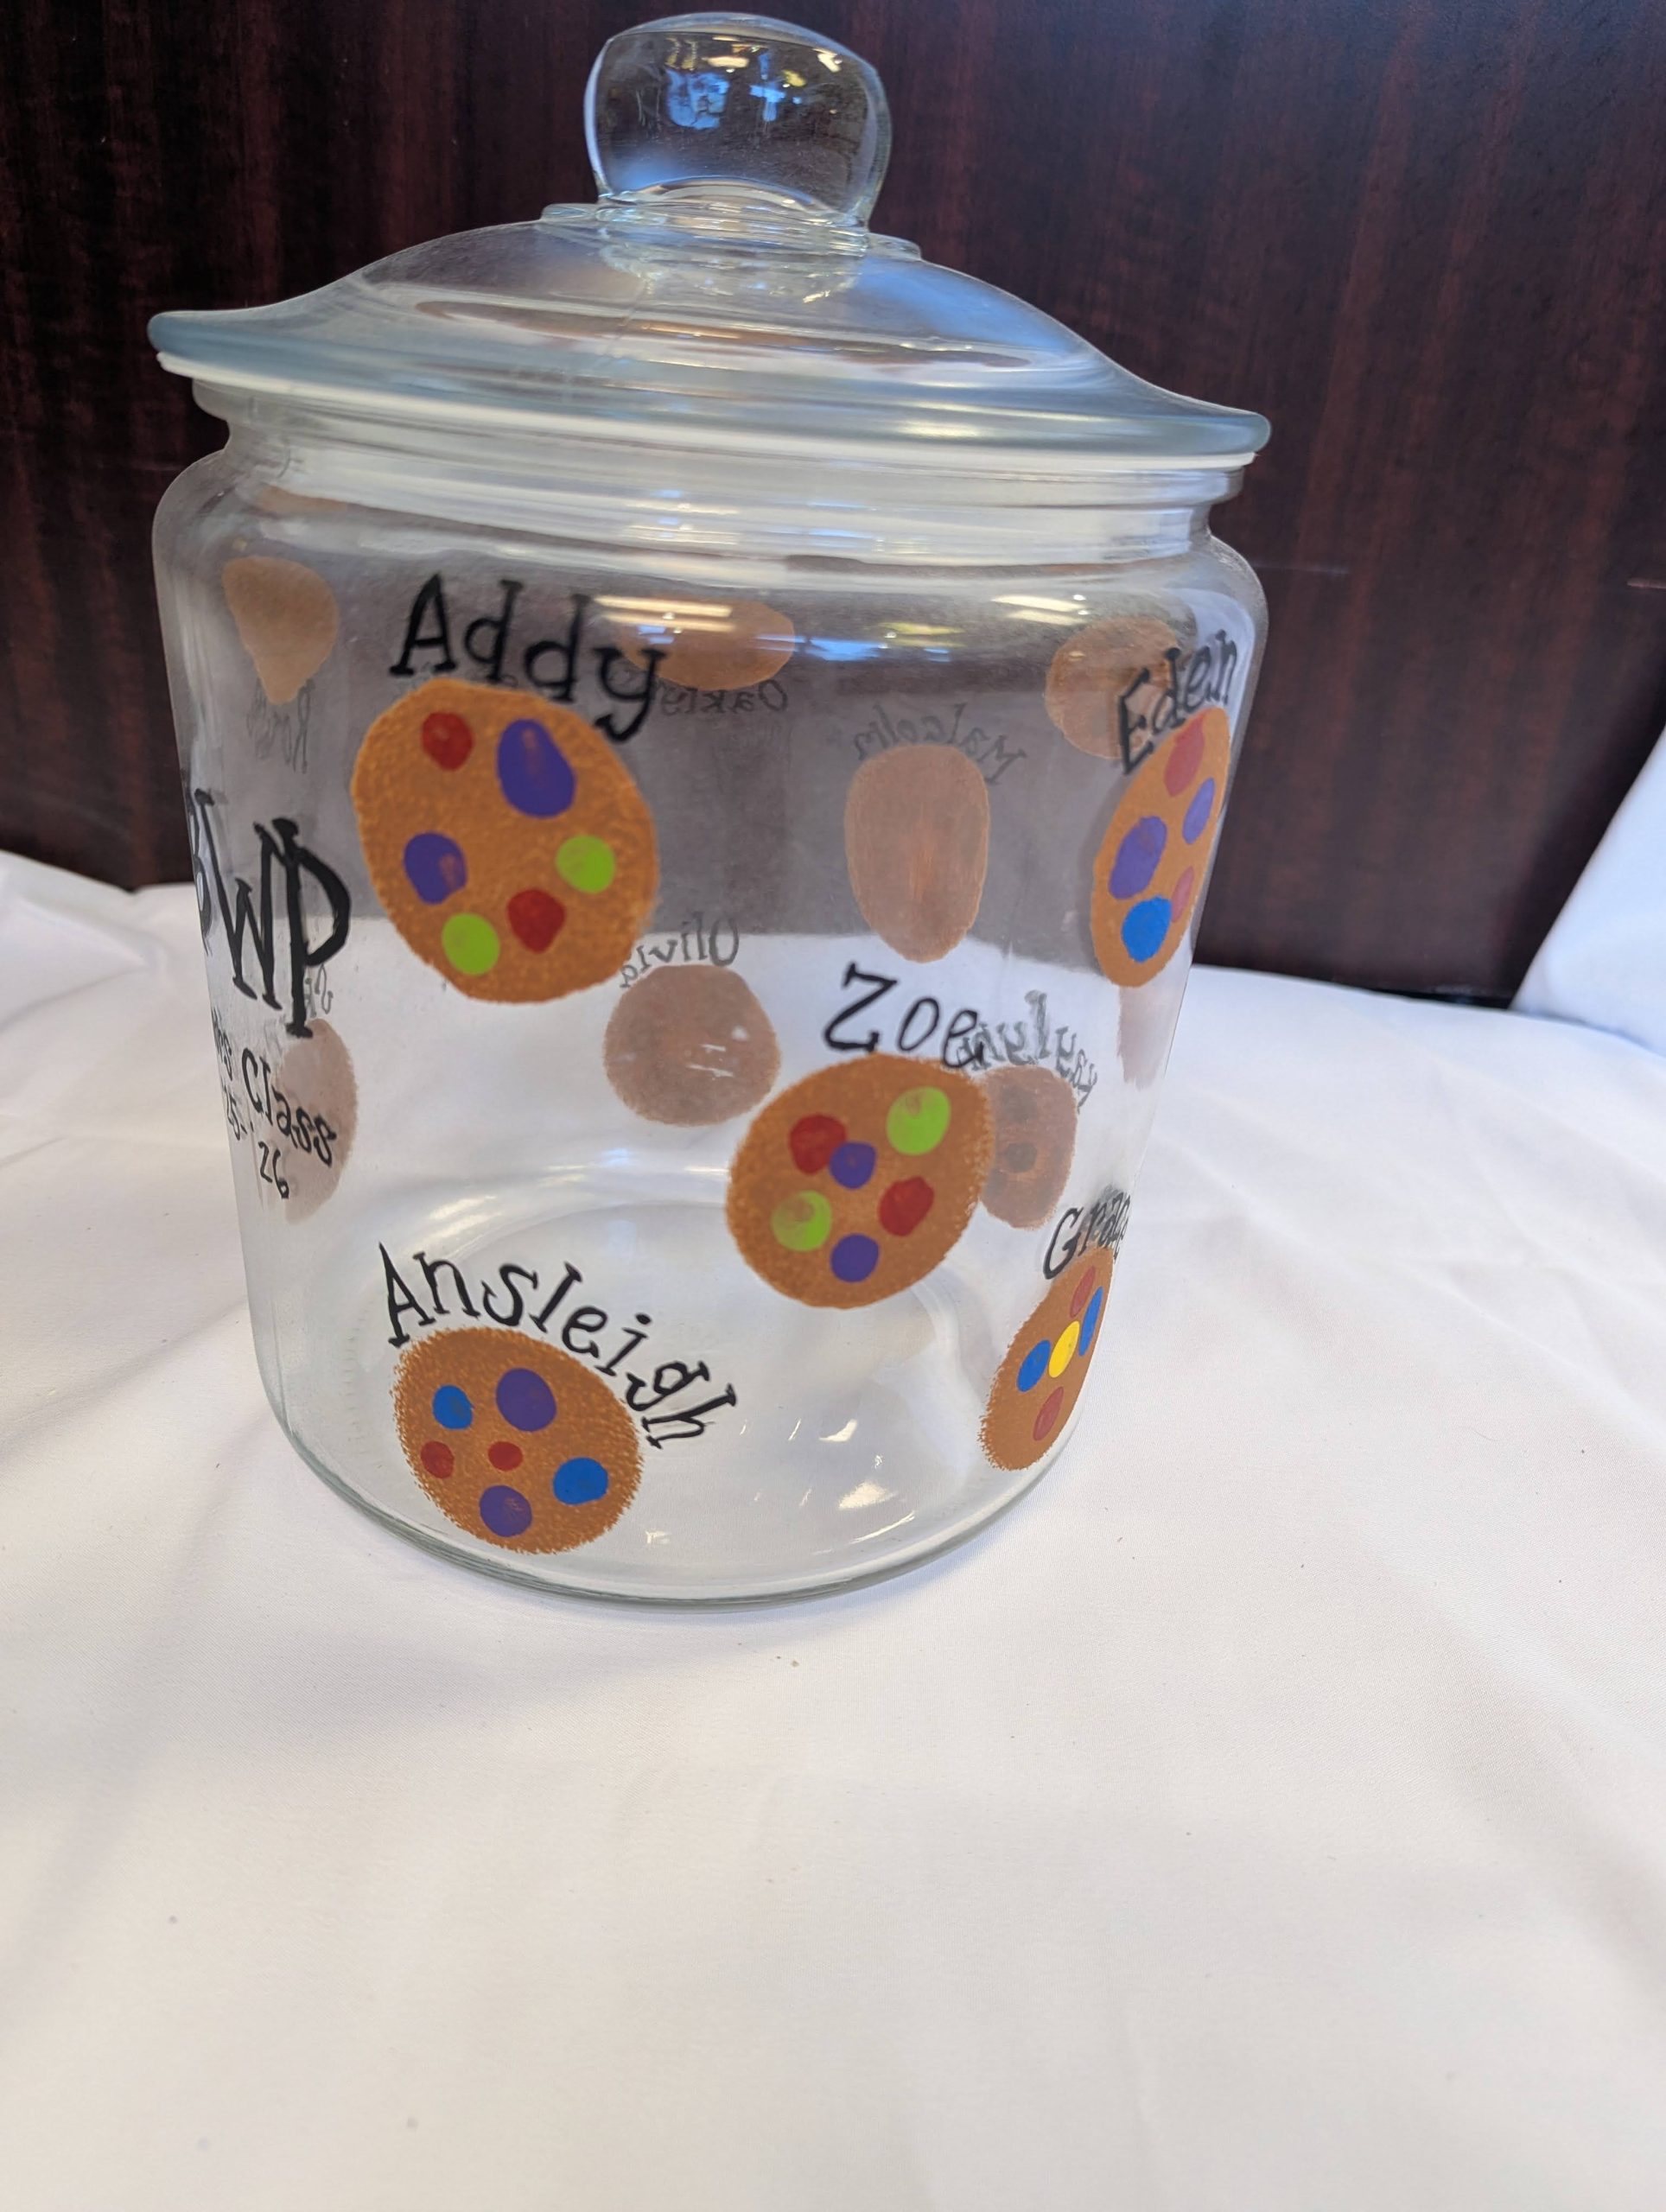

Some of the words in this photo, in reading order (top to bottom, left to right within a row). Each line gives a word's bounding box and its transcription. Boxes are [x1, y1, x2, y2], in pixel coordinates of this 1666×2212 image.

[389, 572, 668, 742] Addy
[1118, 630, 1237, 774] Eden
[823, 961, 983, 1069] Zoe
[241, 1046, 337, 1168] Class
[378, 1241, 737, 1450] Ansleigh
